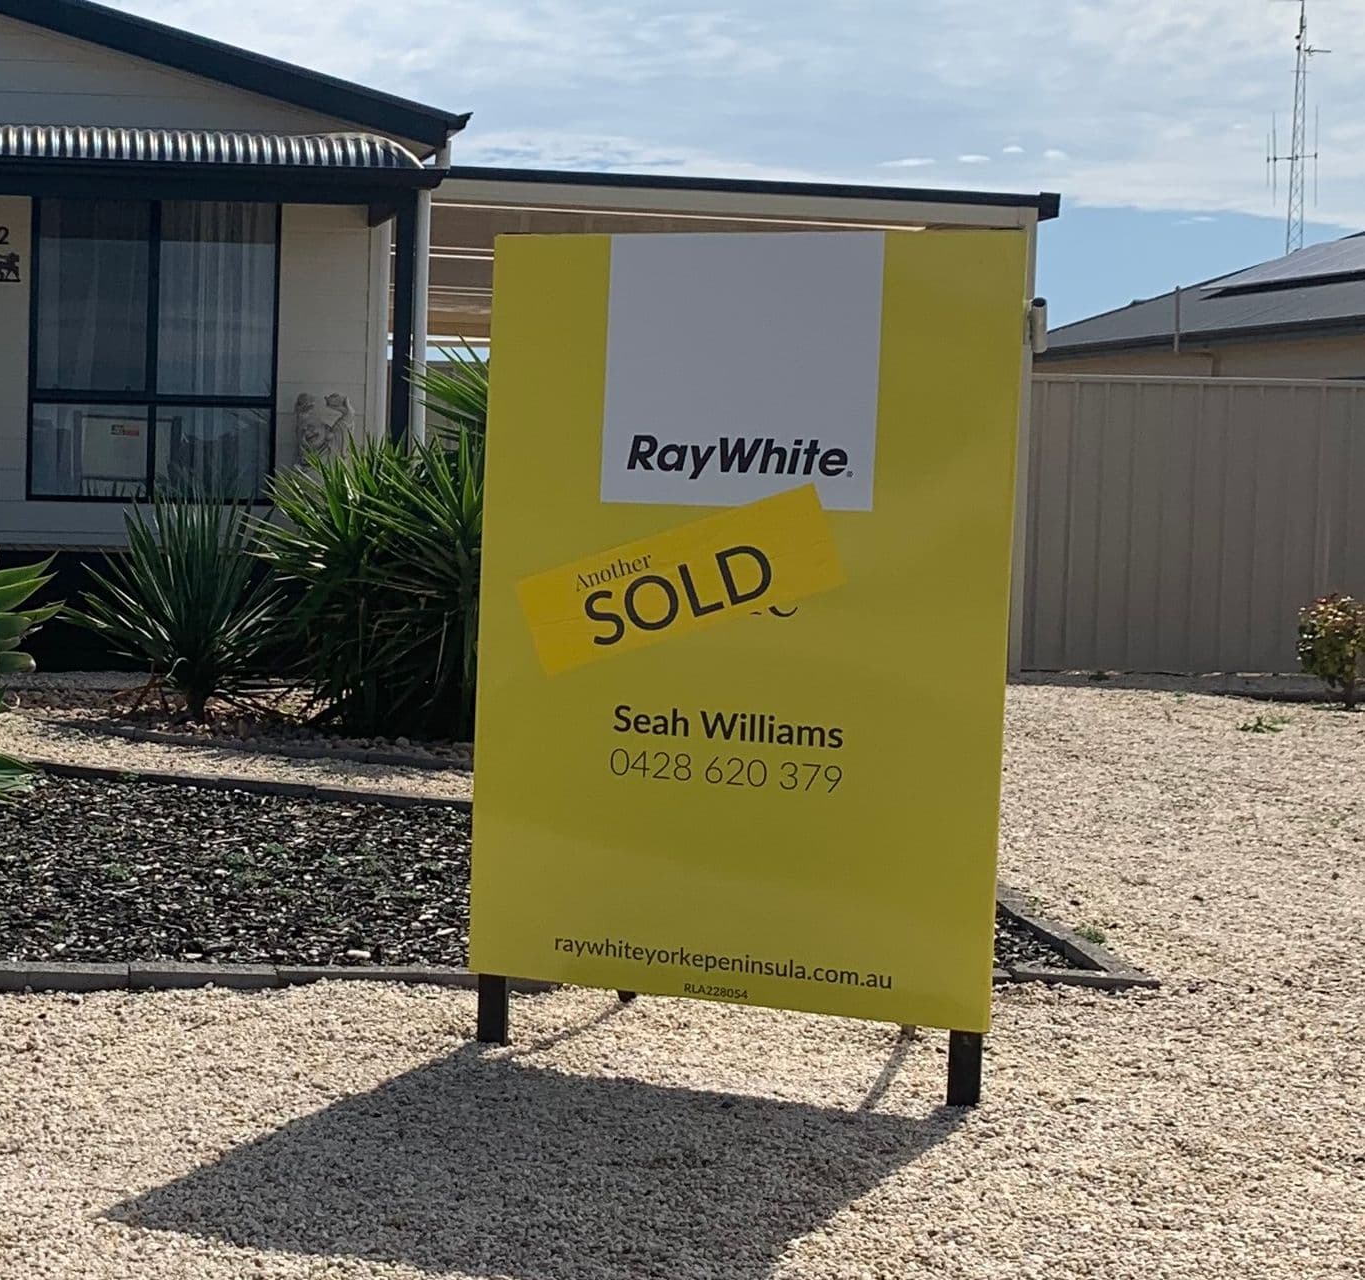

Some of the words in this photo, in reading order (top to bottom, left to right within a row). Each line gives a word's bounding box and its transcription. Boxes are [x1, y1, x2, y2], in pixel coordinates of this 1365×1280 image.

[576, 554, 652, 592] Another
[584, 545, 773, 646] SOLD
[613, 704, 690, 738] Seah
[699, 710, 844, 750] Williams
[610, 748, 692, 782] 0428
[705, 755, 768, 788] 620
[779, 761, 843, 794] 379
[553, 936, 893, 990] raywhiteyorkepeninsula.com.au
[683, 983, 749, 1000] RLA228054
